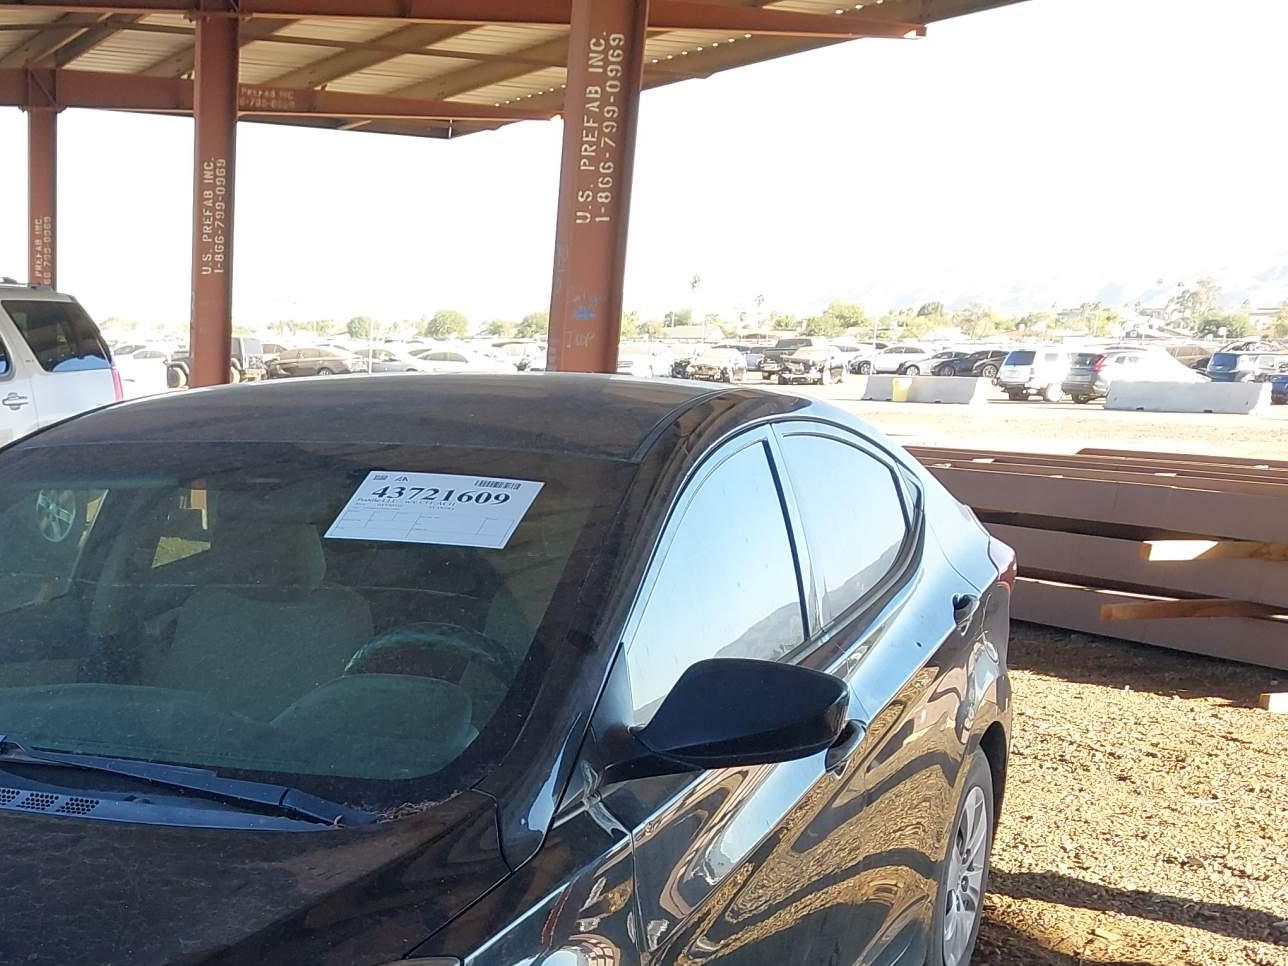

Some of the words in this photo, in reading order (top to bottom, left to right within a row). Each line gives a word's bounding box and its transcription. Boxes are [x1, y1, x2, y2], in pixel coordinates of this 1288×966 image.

[588, 31, 607, 73] INC.
[580, 86, 602, 170] PREFAB
[595, 33, 625, 223] 1-866-799-0969
[202, 190, 213, 242] PREFAB
[213, 158, 226, 273] 1-866-799-0969
[576, 184, 594, 224] U.S.
[201, 250, 213, 275] U.S.
[371, 486, 511, 505] 43721609
